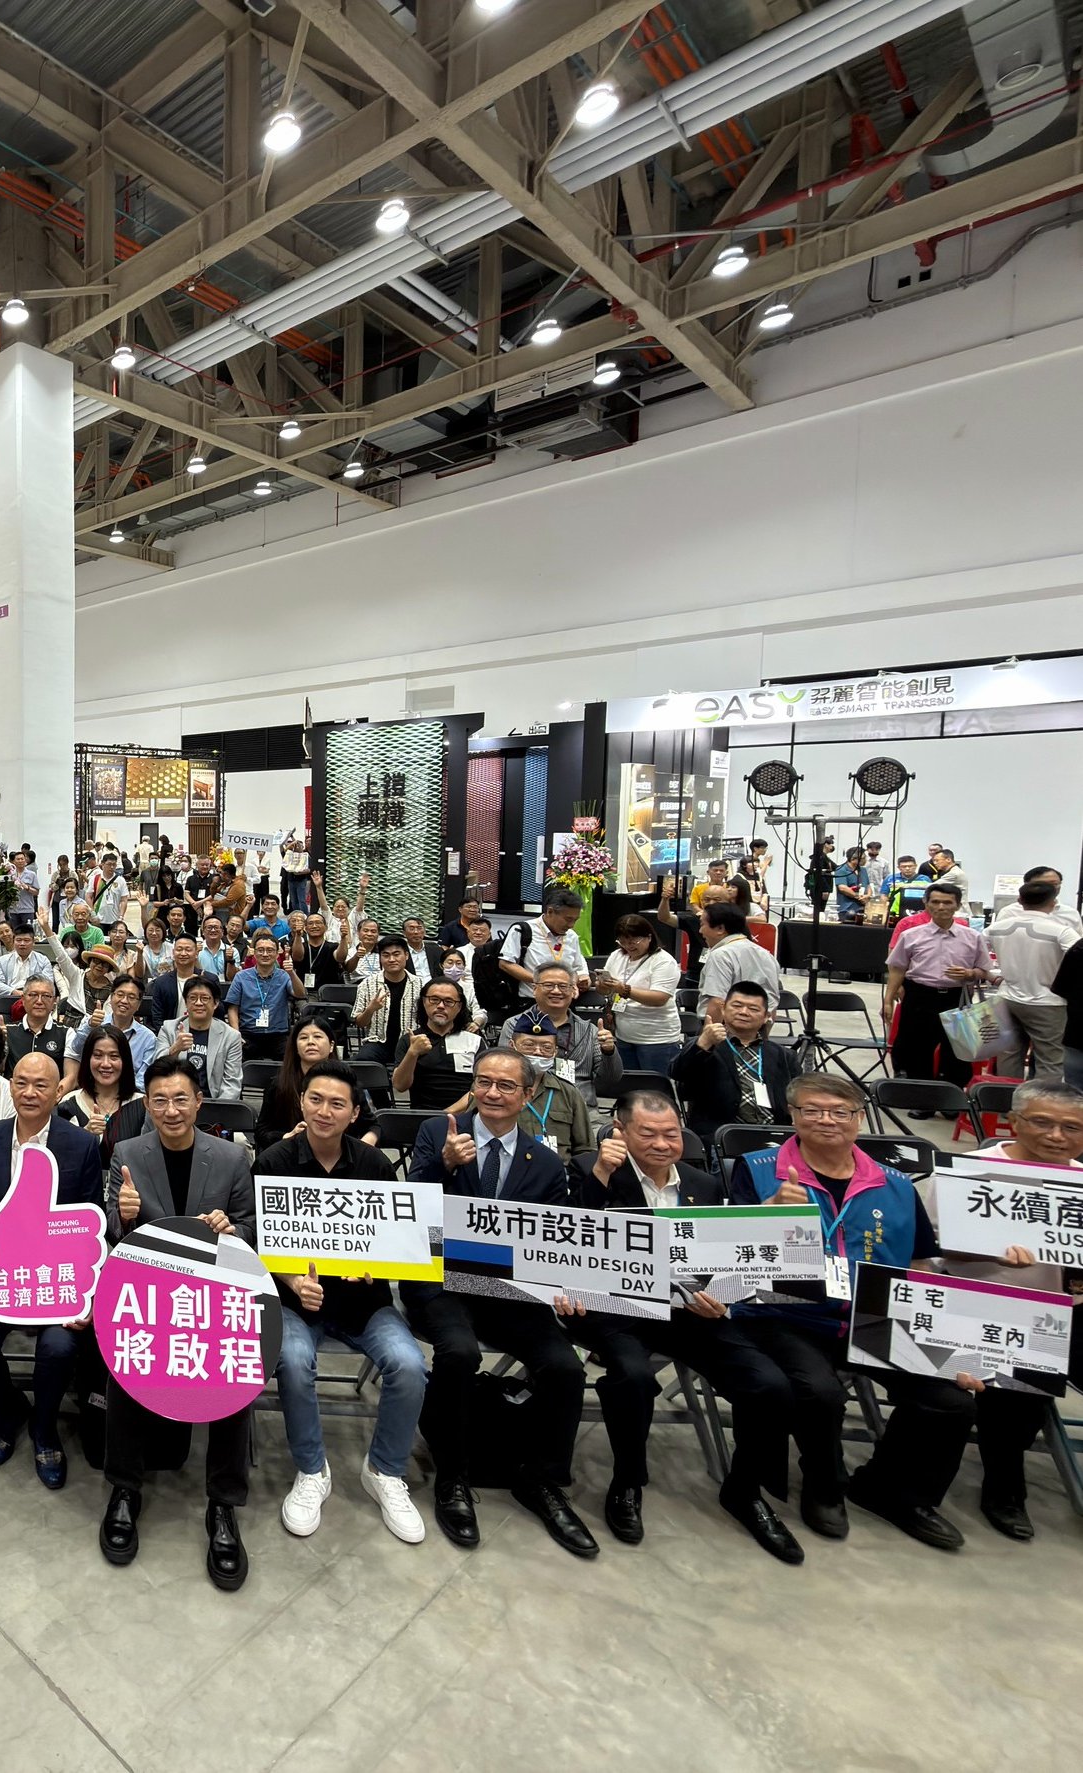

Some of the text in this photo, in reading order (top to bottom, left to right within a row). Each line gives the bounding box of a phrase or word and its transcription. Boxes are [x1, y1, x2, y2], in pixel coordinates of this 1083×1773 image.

[837, 703, 877, 714] SMART
[227, 834, 269, 847] TOSTEM
[261, 1185, 417, 1222] 國際交流日
[47, 1219, 80, 1227] TAICHUNG
[48, 1226, 90, 1236] DESIGN WEEK
[263, 1219, 376, 1236] GLOBAL DESIGN
[466, 1203, 654, 1254] 城市設計日
[674, 1221, 695, 1240] 環
[264, 1235, 371, 1253] EXCHANGE DAY
[116, 1250, 195, 1275] TAICHUNG DESIGN WEEK
[523, 1248, 654, 1276] URBAN DESIGN
[669, 1245, 779, 1264] 與 淨零
[621, 1278, 655, 1293] DAY
[913, 1312, 933, 1333] 與
[981, 1323, 1025, 1348] 室內
[925, 1337, 962, 1349] RESIDENTIAL
[977, 1346, 1005, 1354] INTERIOR
[982, 1355, 1005, 1364] DESIGN
[1011, 1359, 1058, 1372] CONSTRUCTION
